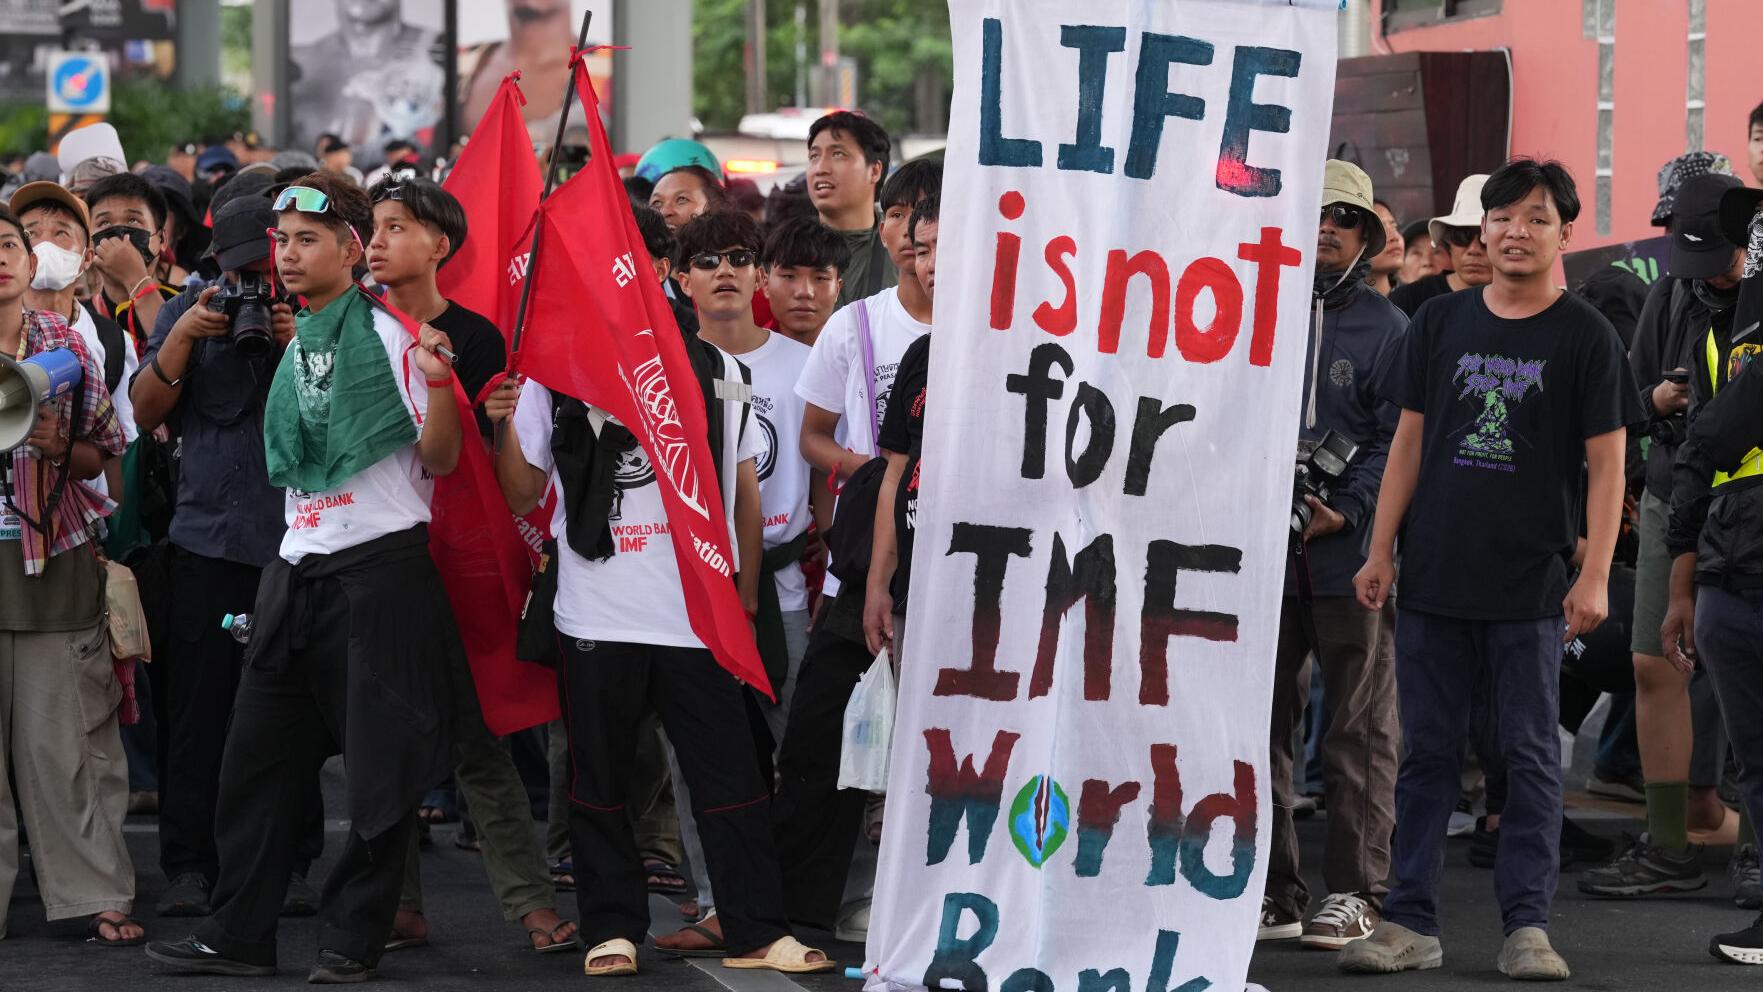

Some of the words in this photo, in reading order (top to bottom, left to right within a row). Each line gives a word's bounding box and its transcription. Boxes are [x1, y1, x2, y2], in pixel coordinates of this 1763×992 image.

[978, 17, 1302, 198] LIFE
[990, 190, 1078, 337] is
[1098, 226, 1302, 367] not
[325, 492, 355, 508] BANK
[1005, 343, 1197, 496] for
[612, 525, 652, 536] WORLD
[619, 536, 648, 552] IMF
[932, 521, 1243, 706] IMF
[922, 727, 1258, 900] World
